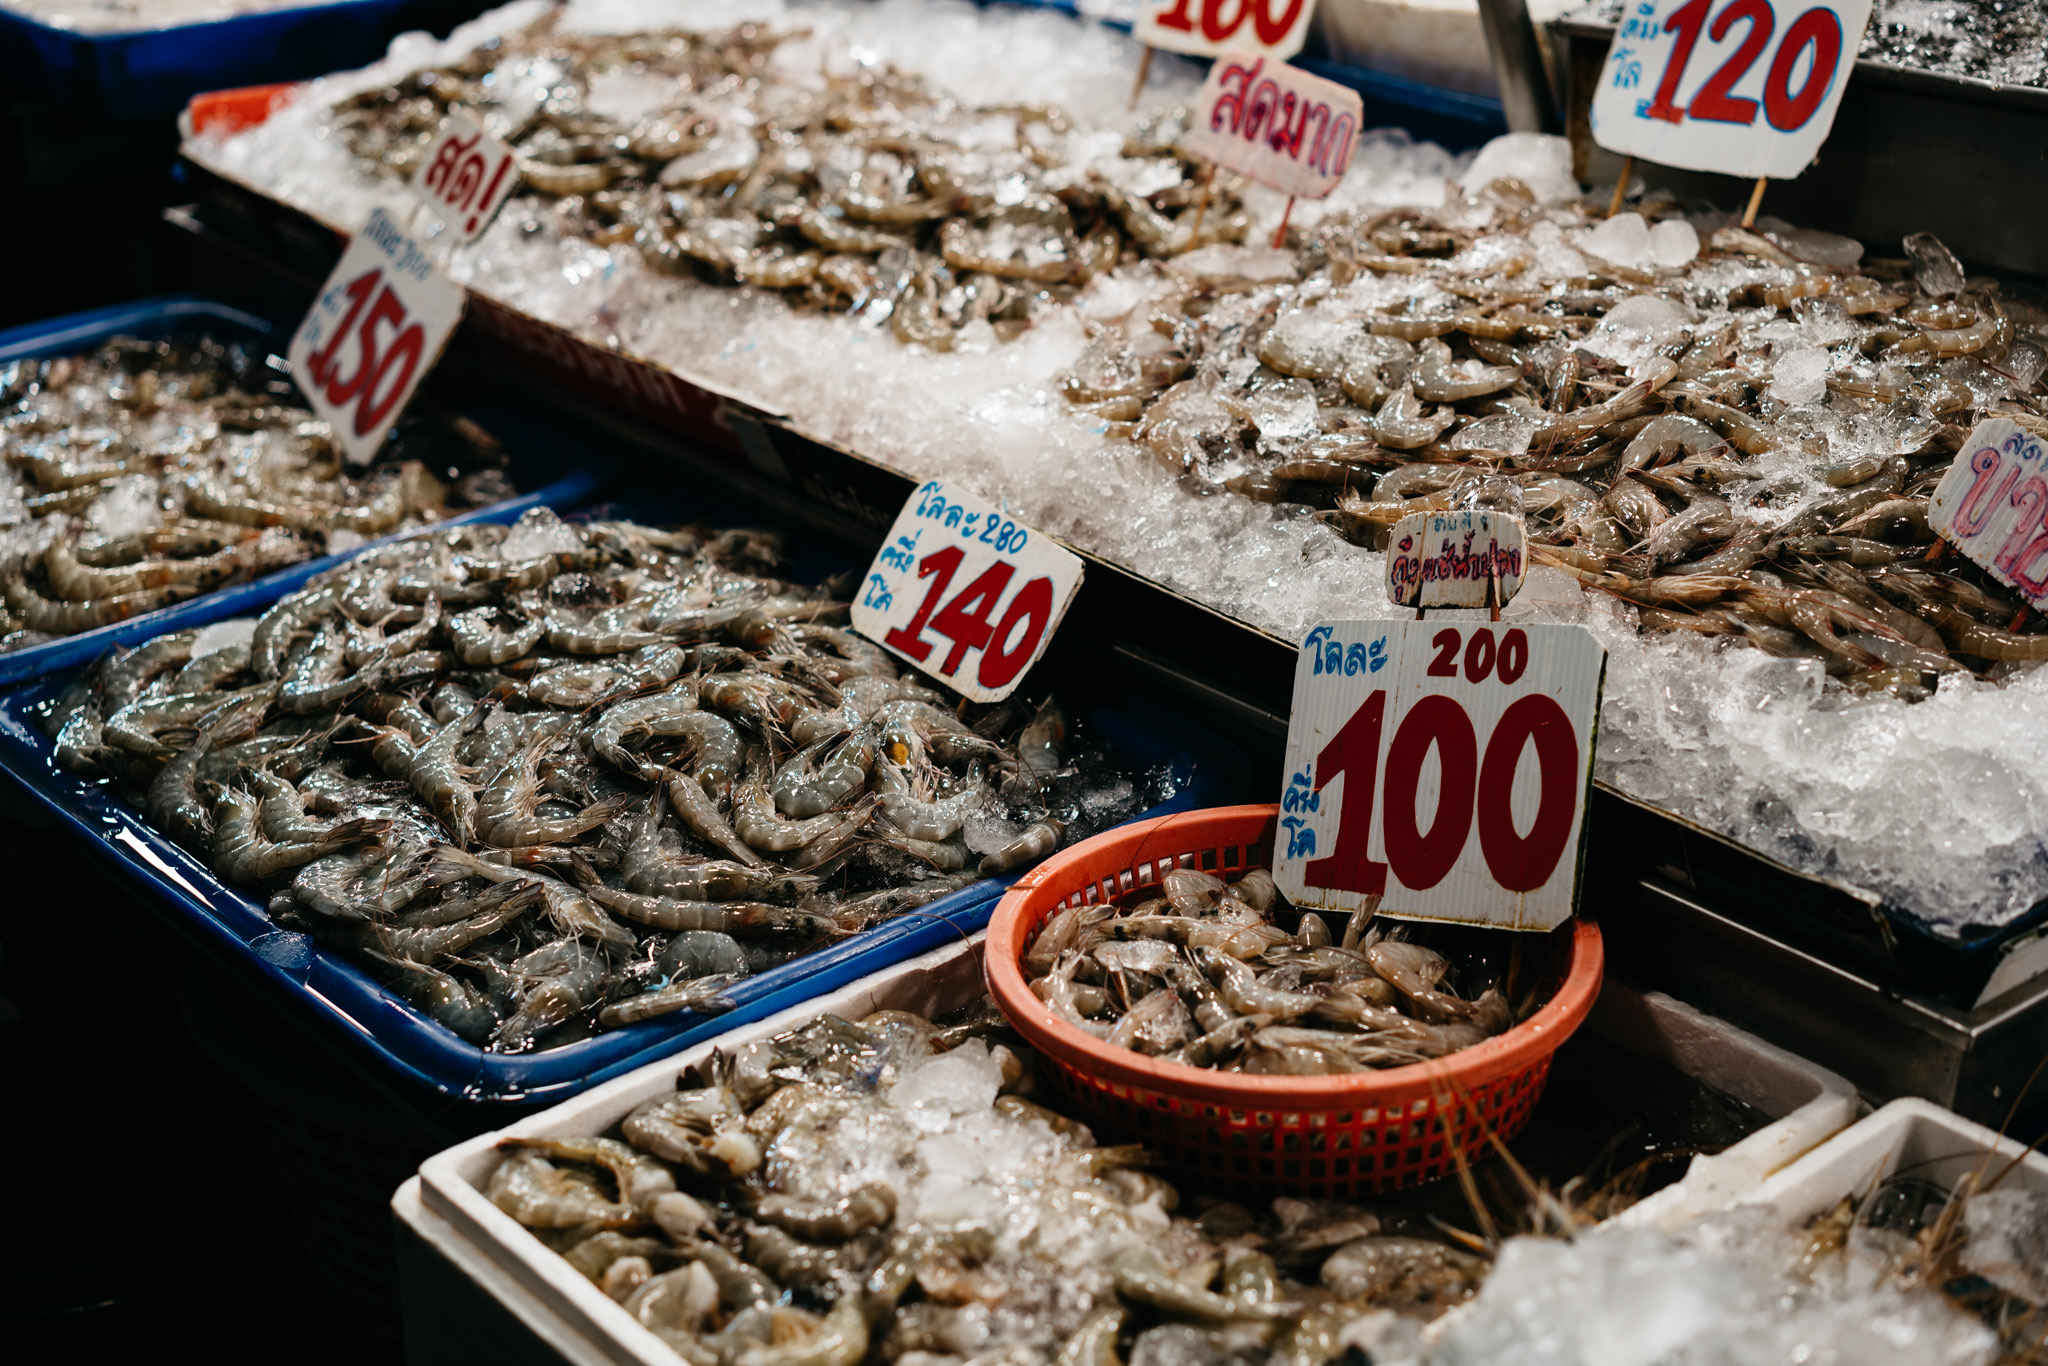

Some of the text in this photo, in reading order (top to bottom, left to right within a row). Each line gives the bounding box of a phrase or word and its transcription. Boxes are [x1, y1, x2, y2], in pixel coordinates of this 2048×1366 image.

[1209, 56, 1355, 178] สดมาก
[1646, 0, 1843, 133] 120
[425, 132, 515, 235] สด!
[307, 268, 426, 438] 150
[915, 481, 981, 539] โลละ
[978, 513, 1029, 555] 280
[883, 545, 1055, 690] 140
[1304, 625, 1529, 685] โลละ 200
[1281, 815, 1317, 861] โล
[1303, 689, 1580, 899] 100
